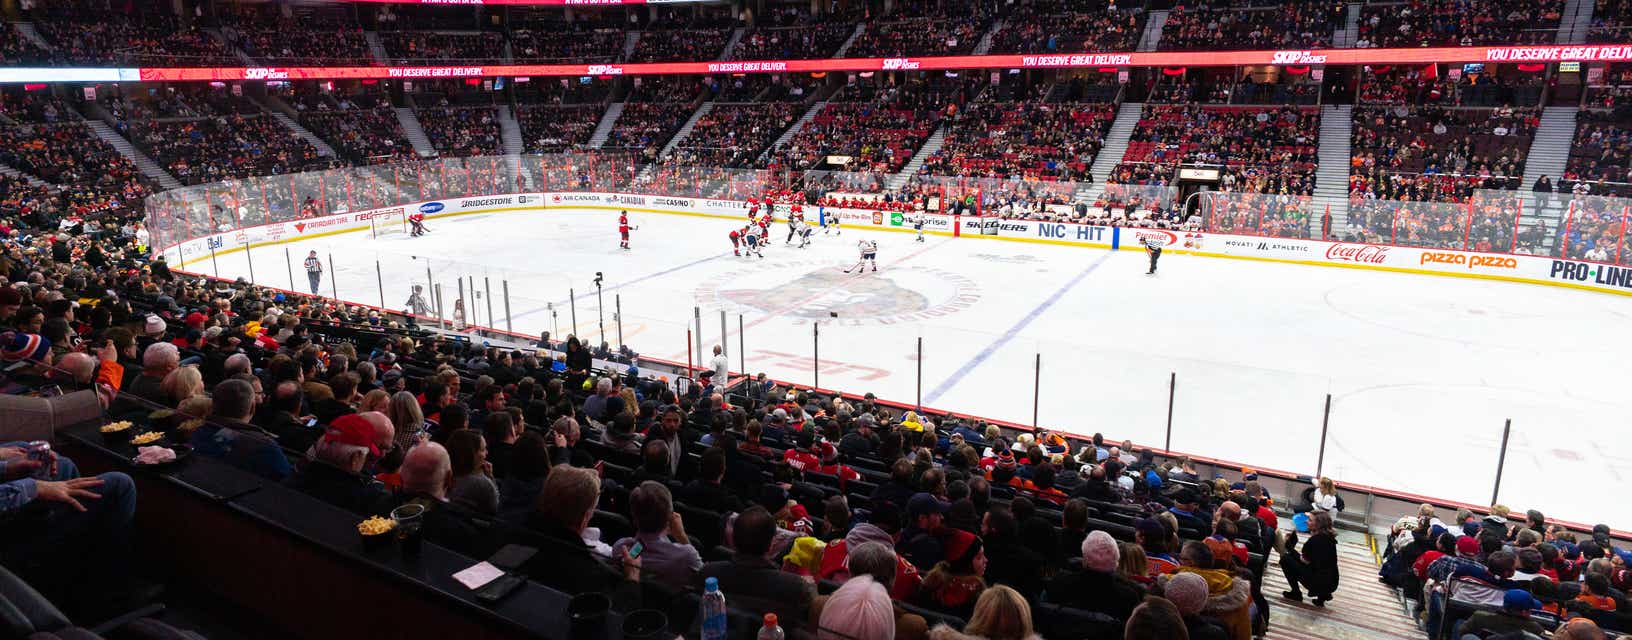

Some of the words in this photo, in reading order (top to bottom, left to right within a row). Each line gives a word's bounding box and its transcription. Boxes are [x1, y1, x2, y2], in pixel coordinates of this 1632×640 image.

[1272, 51, 1302, 64] SKIP
[1486, 49, 1510, 60] YOU
[1510, 48, 1558, 60] DESERVE
[1560, 47, 1600, 60] GREAT
[882, 59, 902, 69] SKIP
[1022, 56, 1037, 66] YOU
[1038, 56, 1070, 66] DESERVE
[1070, 55, 1094, 65] GREAT
[1094, 55, 1131, 65] DELIVERY.
[389, 68, 402, 77] YOU
[403, 68, 431, 77] DESERVE
[432, 68, 452, 76] GREAT
[452, 67, 483, 76] DELIVERY.
[587, 65, 606, 75] SKIP
[708, 64, 719, 72] YOU
[719, 63, 743, 72] DESERVE
[744, 63, 760, 71] GREAT
[245, 68, 268, 79] SKIP
[461, 197, 513, 208] BRIDGESTONE
[666, 199, 689, 207] CASINO
[307, 219, 335, 229] CANADIAN
[336, 216, 348, 224] TIRE
[966, 221, 1029, 232] SKECHERS
[1038, 223, 1066, 238] NIC
[1077, 226, 1105, 241] HIT
[207, 235, 223, 250] Bell
[1226, 240, 1254, 248] MOVATI
[1272, 244, 1309, 252] ATHLETIC
[1325, 242, 1391, 264] Coca-Cola
[1420, 251, 1466, 265] pizza
[1468, 255, 1518, 269] pizza
